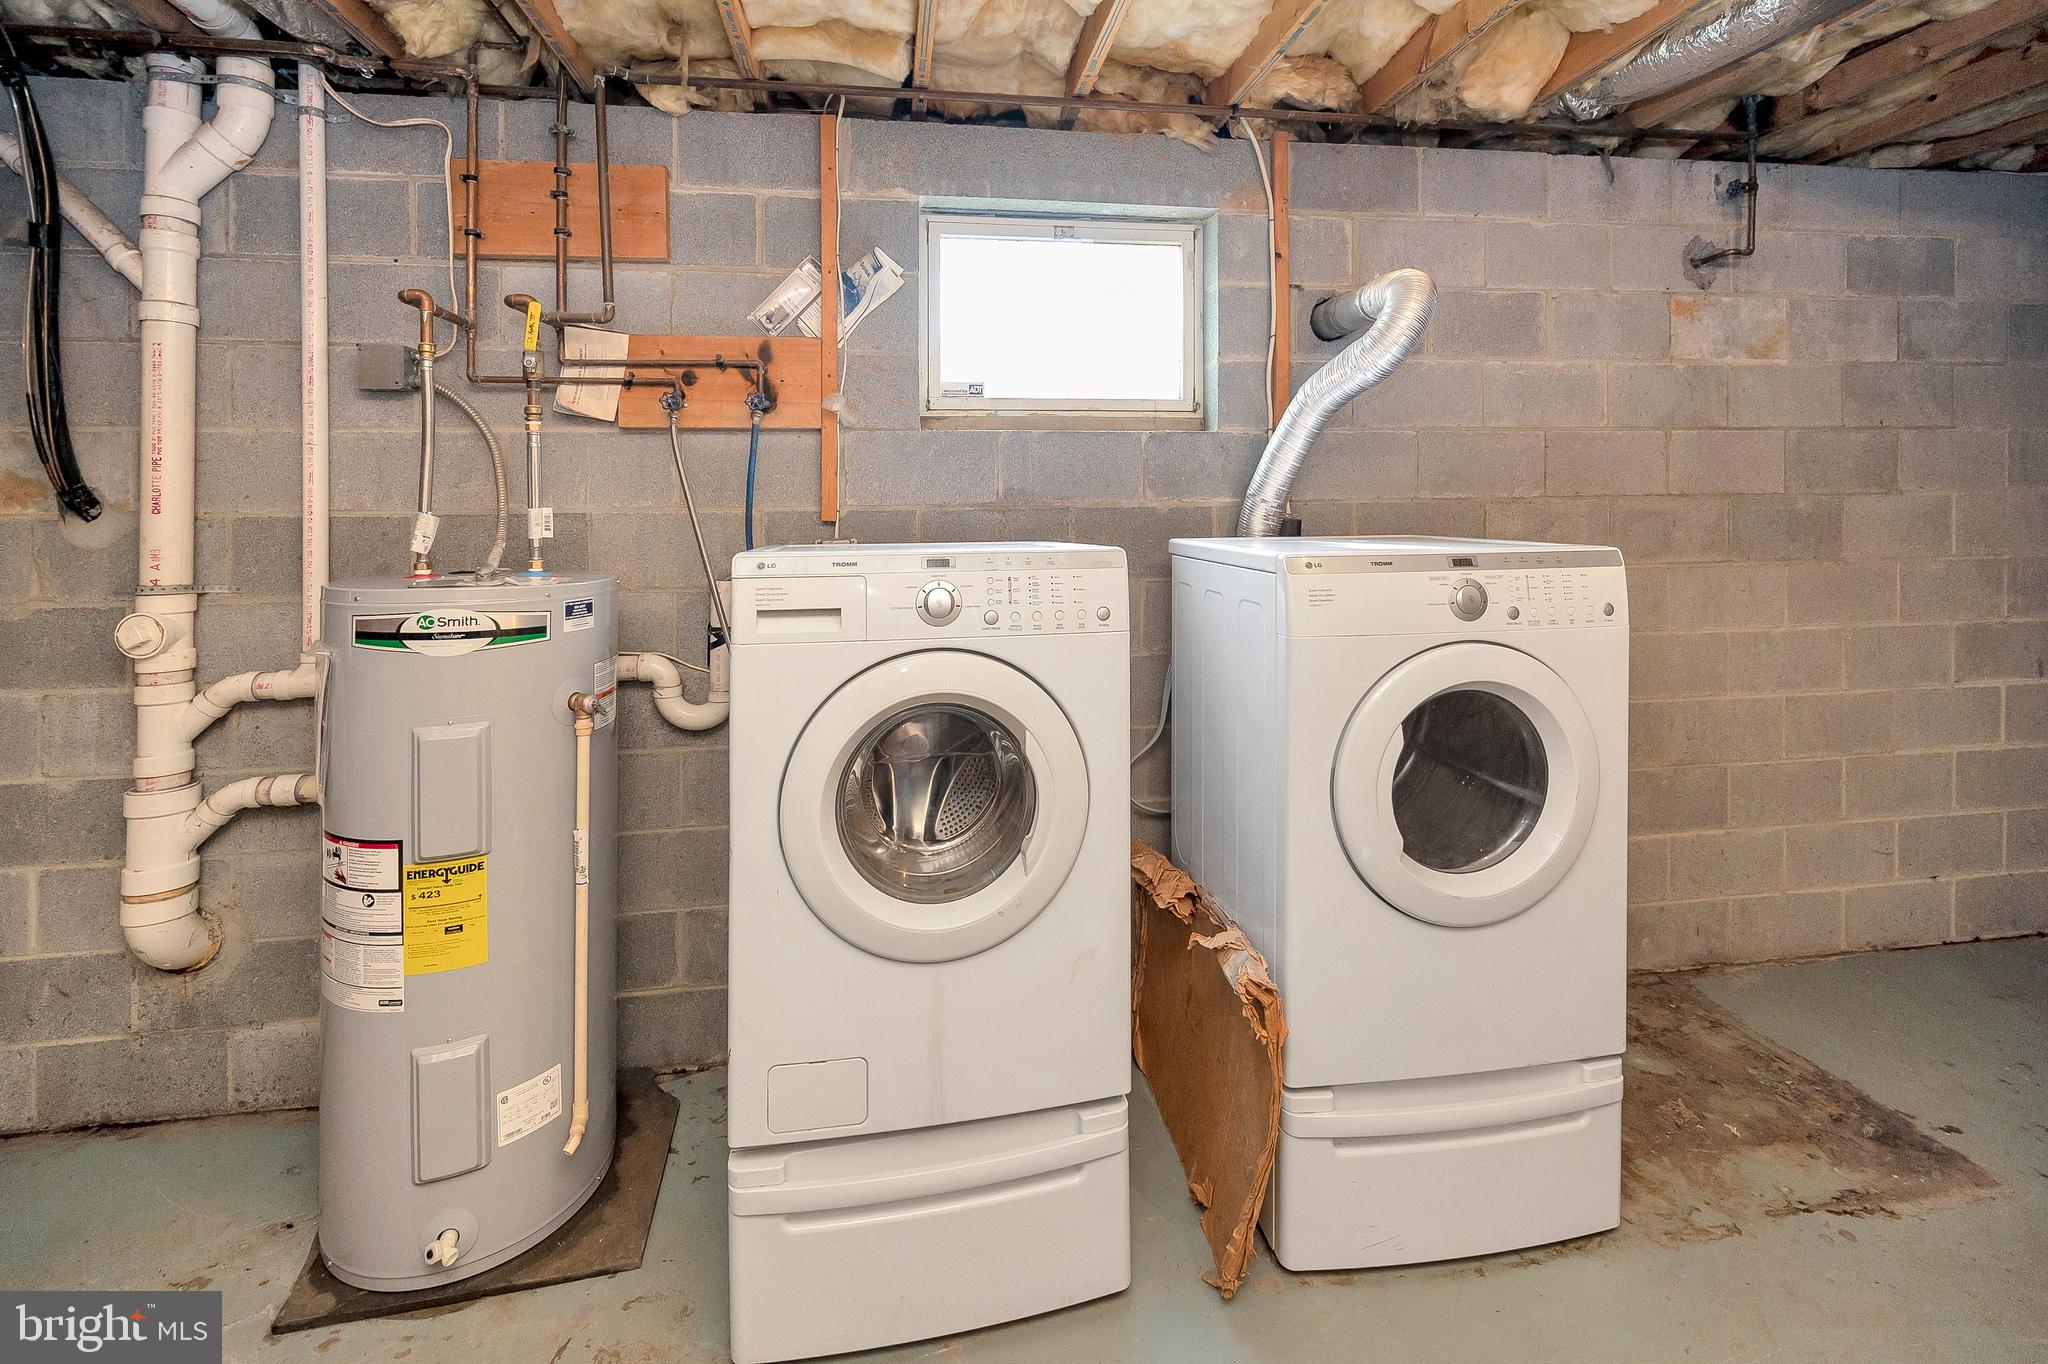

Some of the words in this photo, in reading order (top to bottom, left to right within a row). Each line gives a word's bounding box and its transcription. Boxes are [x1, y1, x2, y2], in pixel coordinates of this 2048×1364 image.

[969, 385, 983, 394] ADT
[151, 456, 162, 473] PIPE
[151, 475, 162, 515] CHARLOTTE
[418, 890, 441, 900] 423
